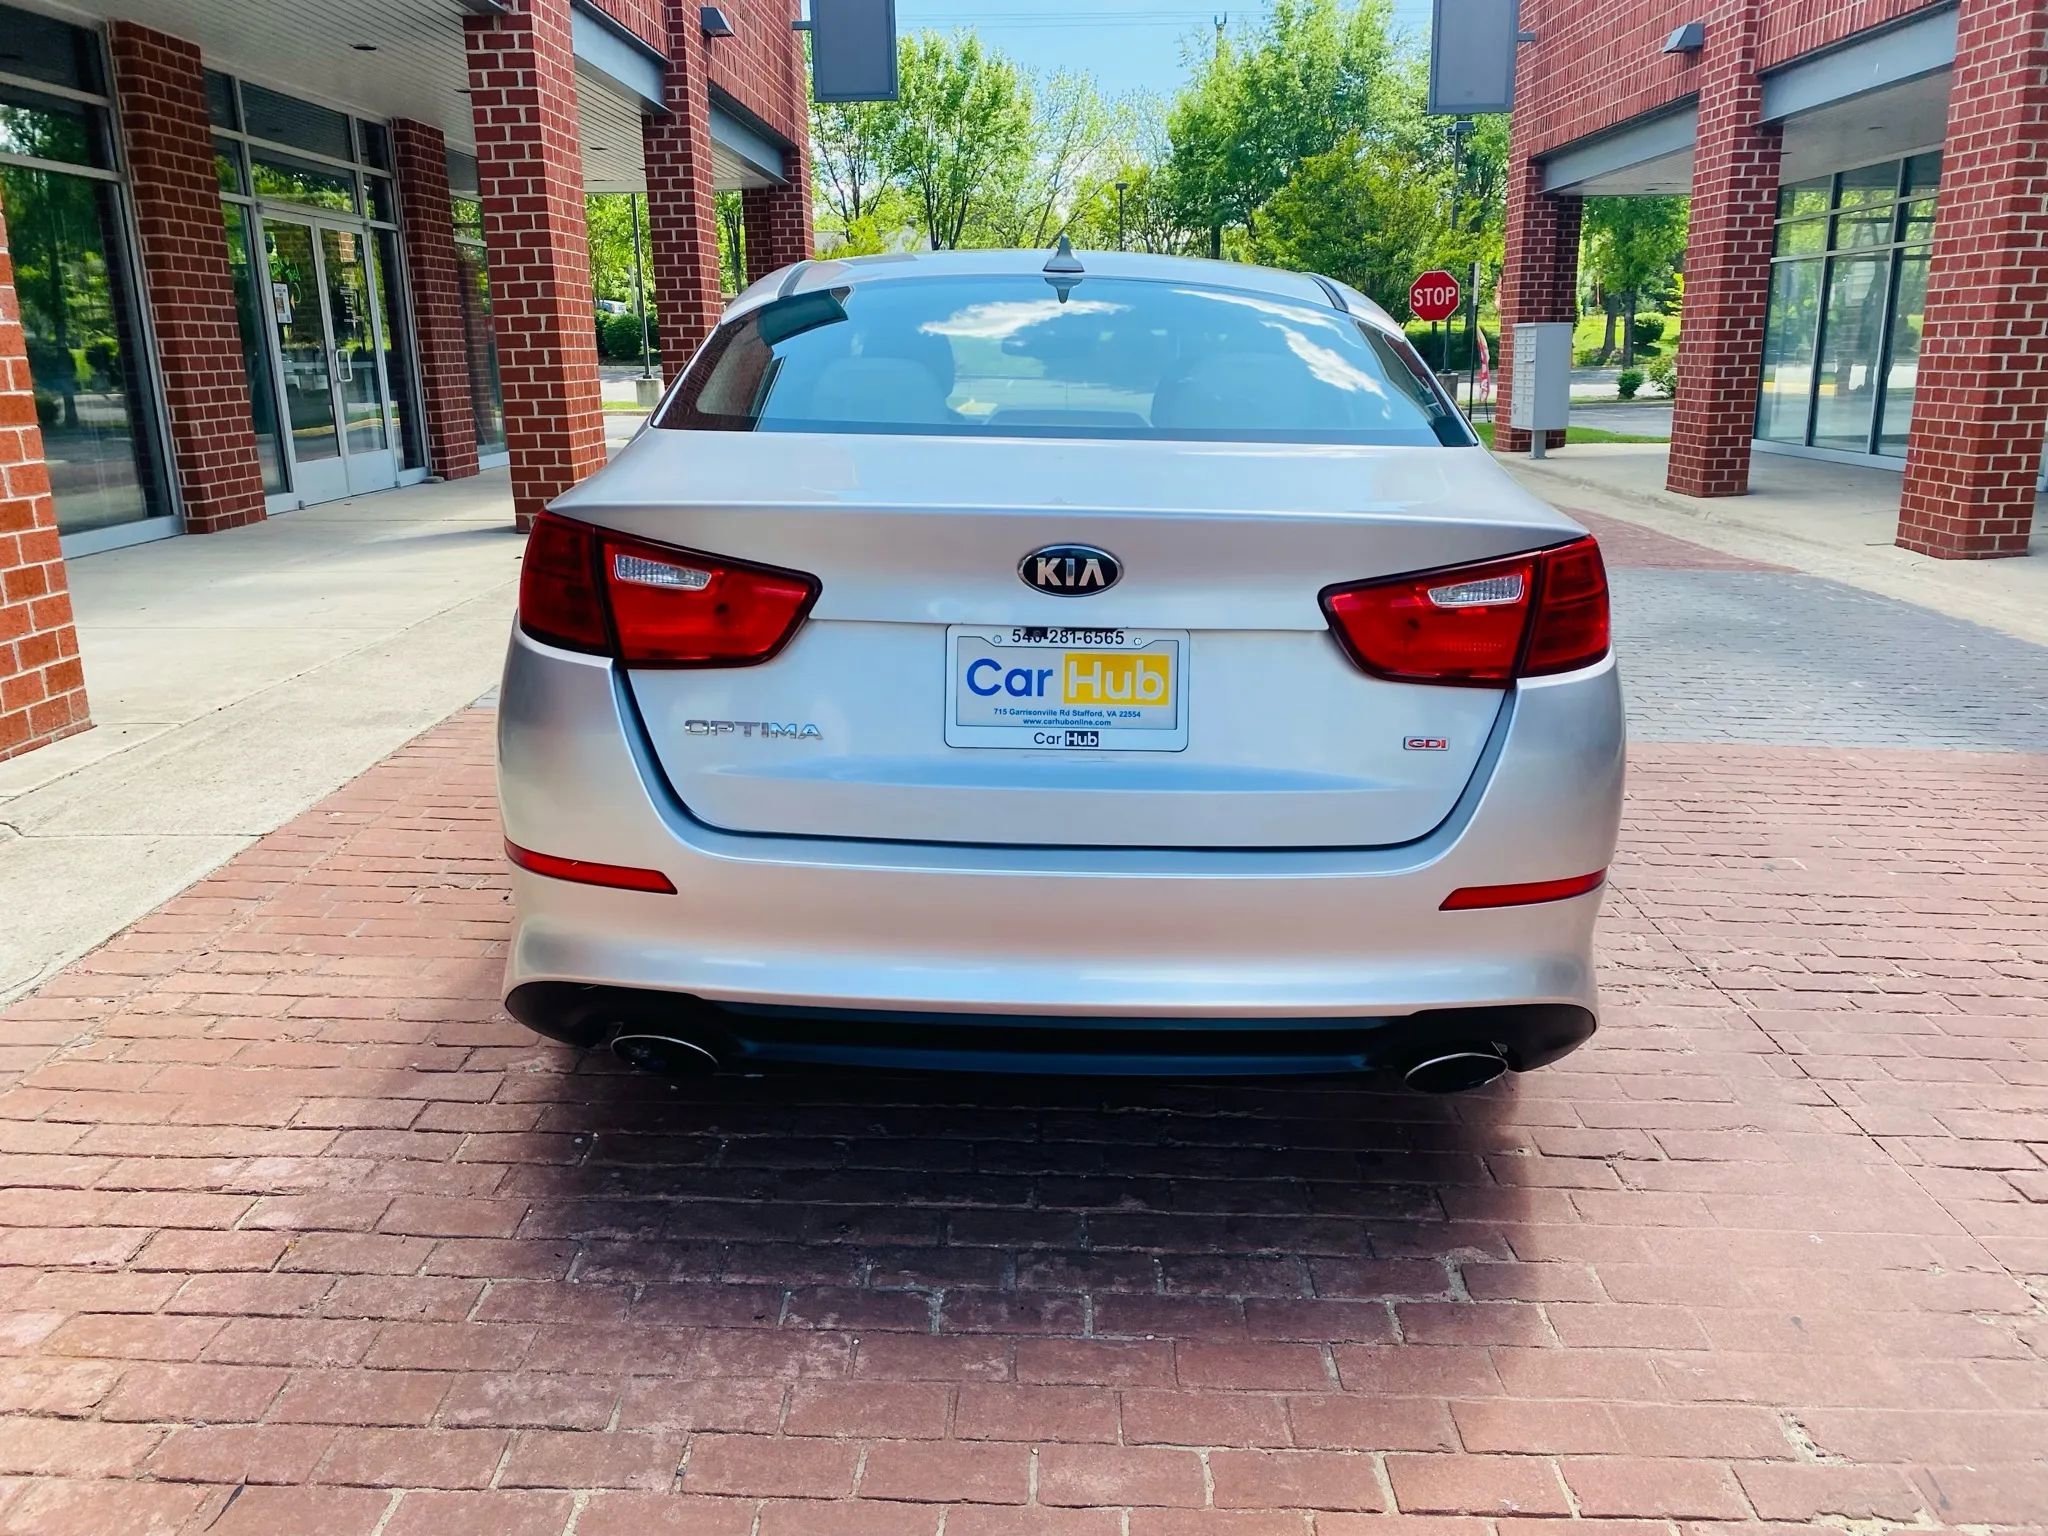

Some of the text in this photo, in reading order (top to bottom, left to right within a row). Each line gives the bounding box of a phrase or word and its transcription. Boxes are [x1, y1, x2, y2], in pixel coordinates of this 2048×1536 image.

[1413, 286, 1456, 307] STOP
[1036, 557, 1105, 586] KIA
[966, 658, 1165, 700] Car Hub
[1009, 708, 1058, 716] Garrisonville
[1072, 710, 1104, 718] Stafford,
[684, 719, 824, 740] OPTIMA
[1033, 732, 1098, 746] Car Hub
[1408, 739, 1446, 748] GDI
